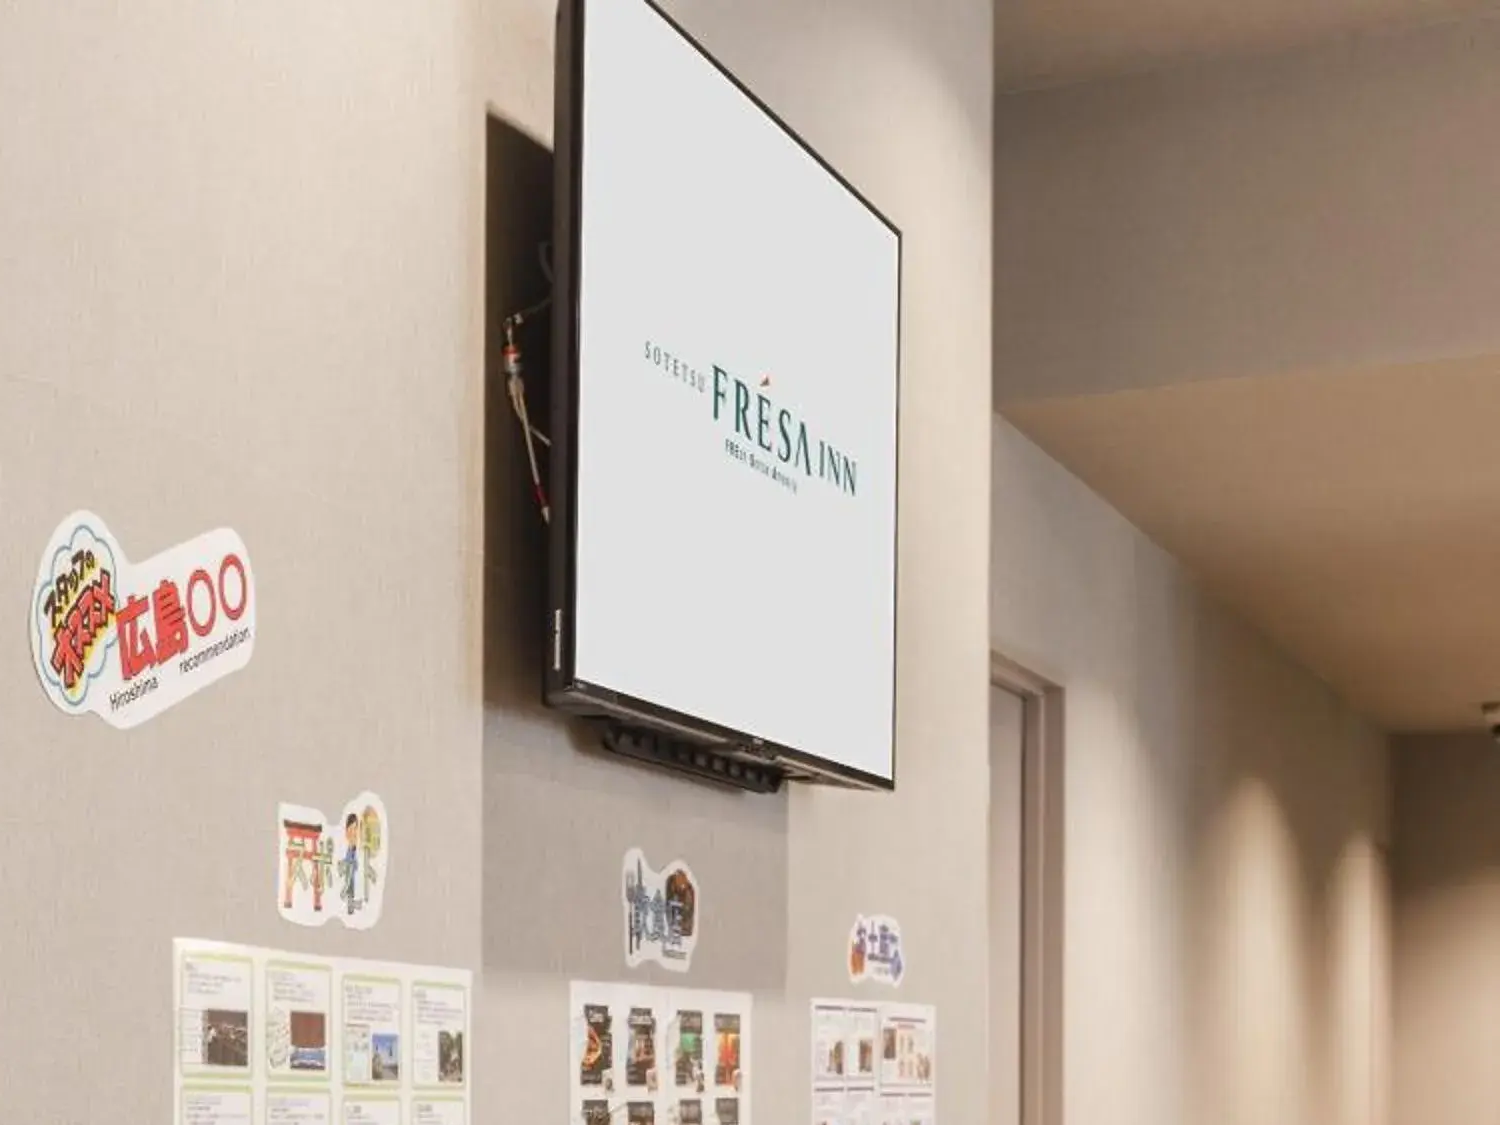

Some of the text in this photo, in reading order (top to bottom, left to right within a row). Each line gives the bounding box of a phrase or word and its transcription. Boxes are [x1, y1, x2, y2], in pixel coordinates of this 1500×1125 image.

[644, 340, 706, 393] SOTETSU
[818, 440, 857, 497] INN
[109, 626, 251, 711] Hiroshima recommendation
